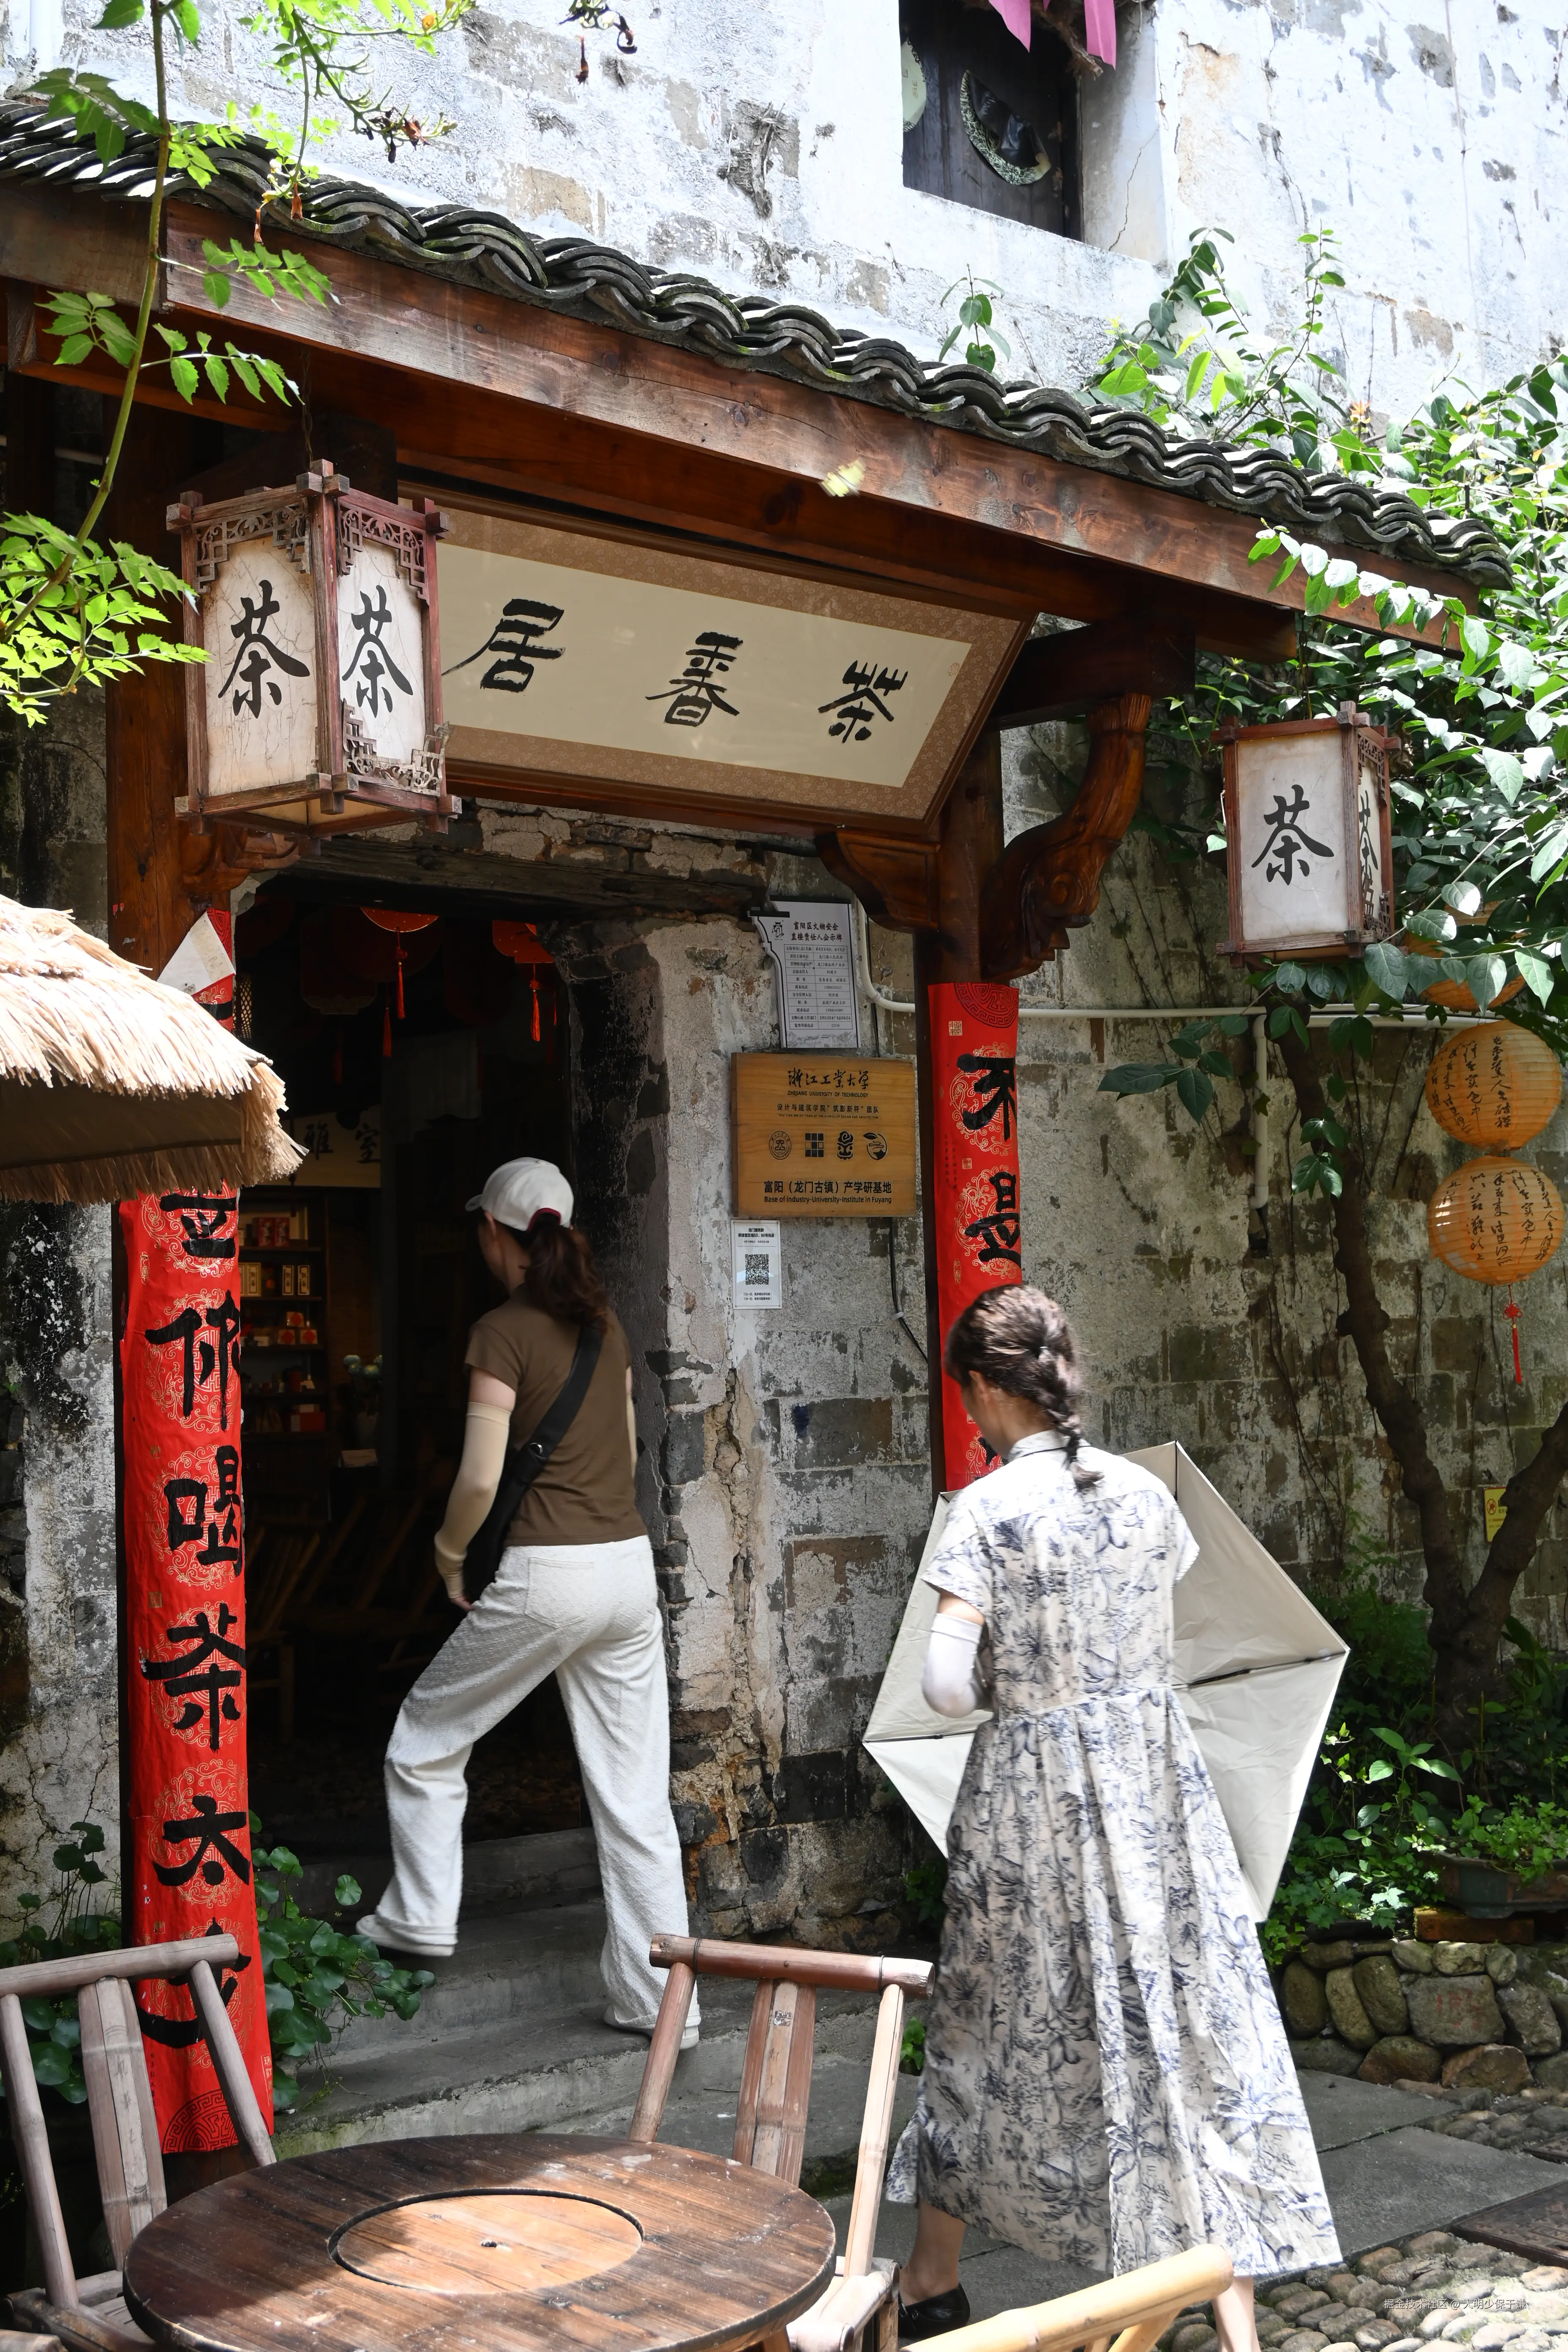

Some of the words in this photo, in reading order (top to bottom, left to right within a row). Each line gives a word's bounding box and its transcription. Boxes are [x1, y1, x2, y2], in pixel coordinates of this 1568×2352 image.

[219, 579, 310, 719] 茶
[342, 584, 413, 719] 茶
[1251, 784, 1334, 885] 茶
[791, 932, 843, 942] 直接责任人公示牌
[793, 921, 839, 931] 富阳区文物安全
[764, 1181, 892, 1194] 富阳（龙门古镇）产学研基地
